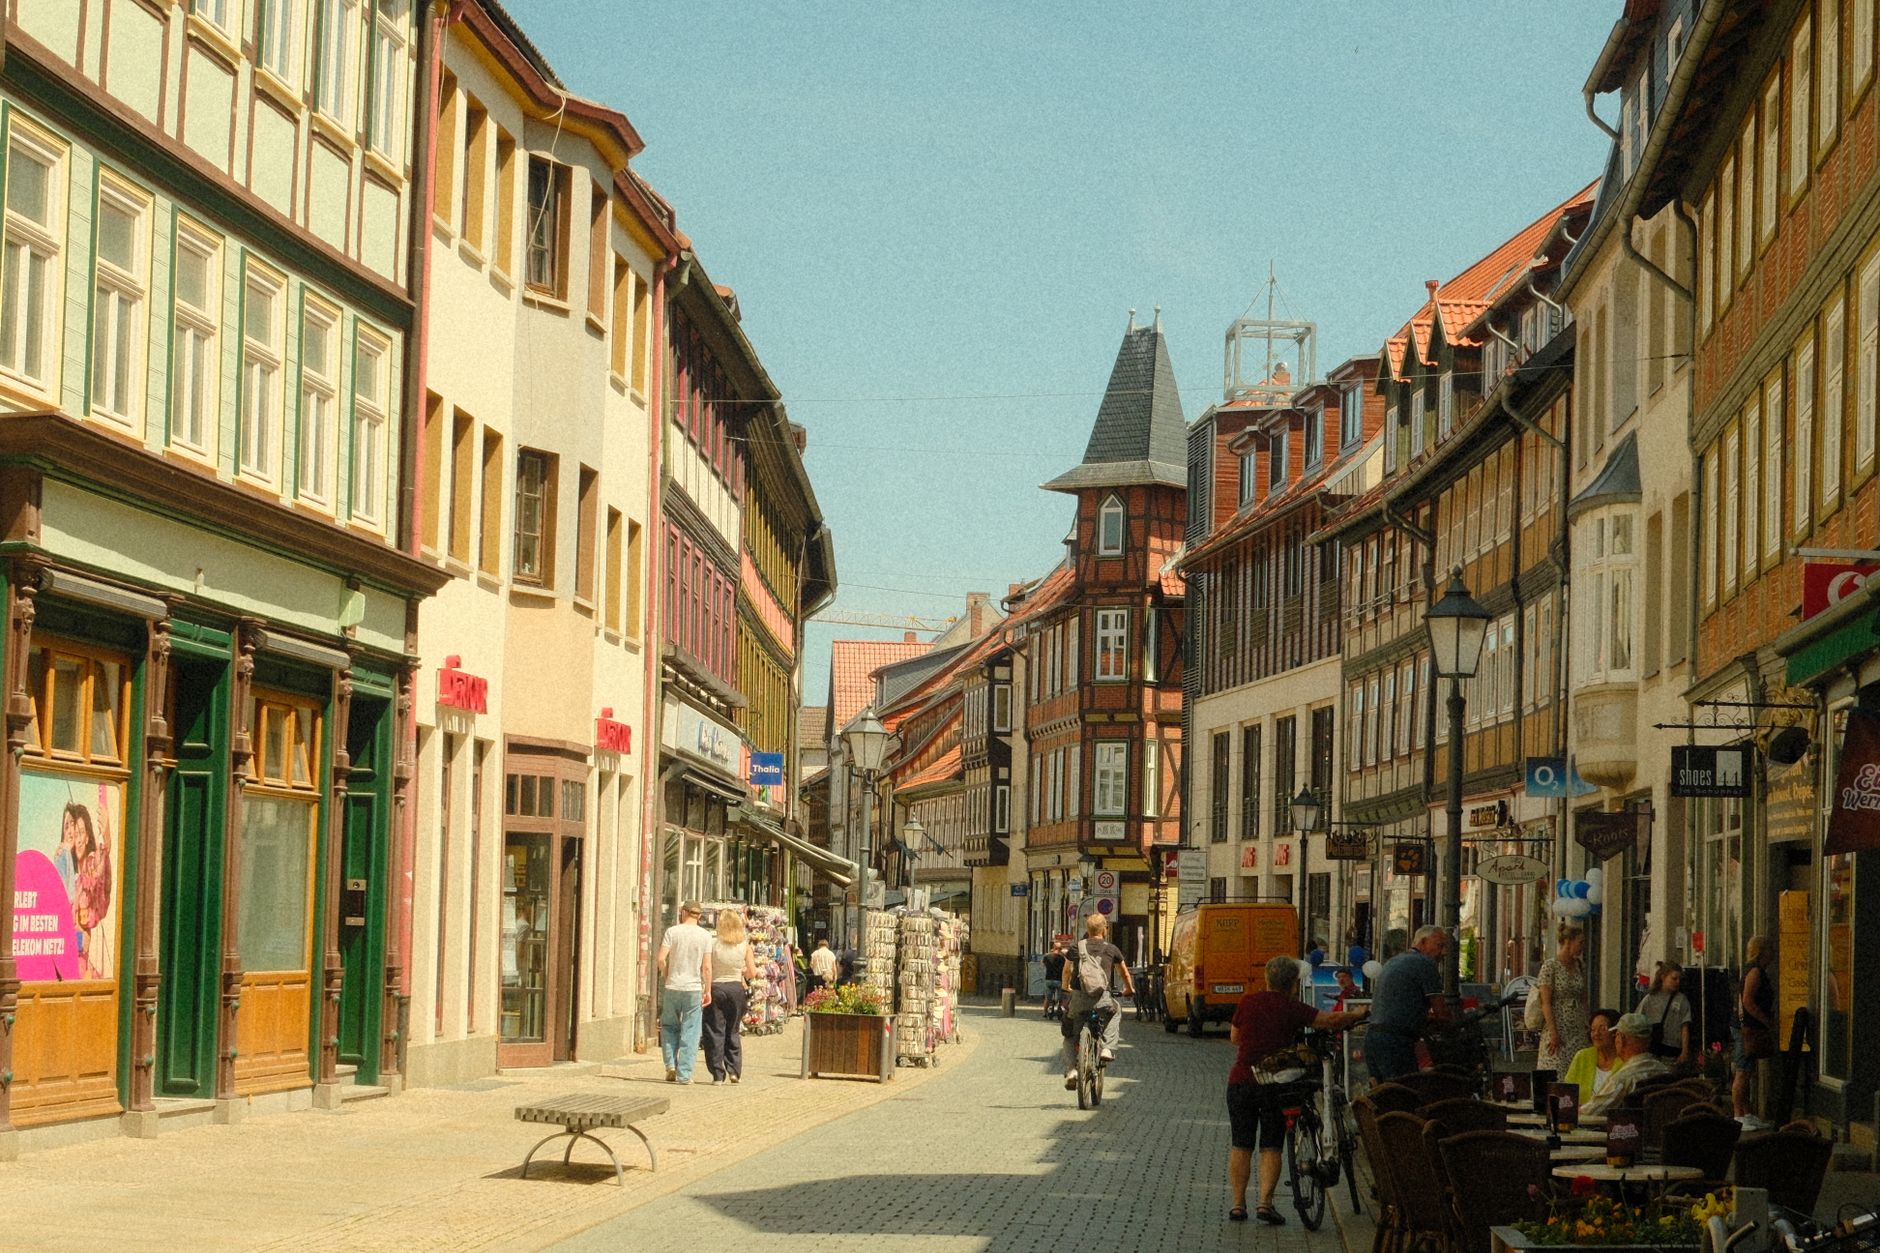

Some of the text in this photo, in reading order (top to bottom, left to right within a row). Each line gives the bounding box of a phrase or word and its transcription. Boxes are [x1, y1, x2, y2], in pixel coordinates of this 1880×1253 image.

[752, 764, 780, 774] Thalia
[1679, 749, 1712, 786] shoes
[1101, 876, 1111, 884] 20
[13, 891, 38, 909] RLEBT
[20, 915, 29, 932] IM
[30, 915, 59, 932] BESTEN
[12, 938, 65, 956] ELEKOM NETZ!
